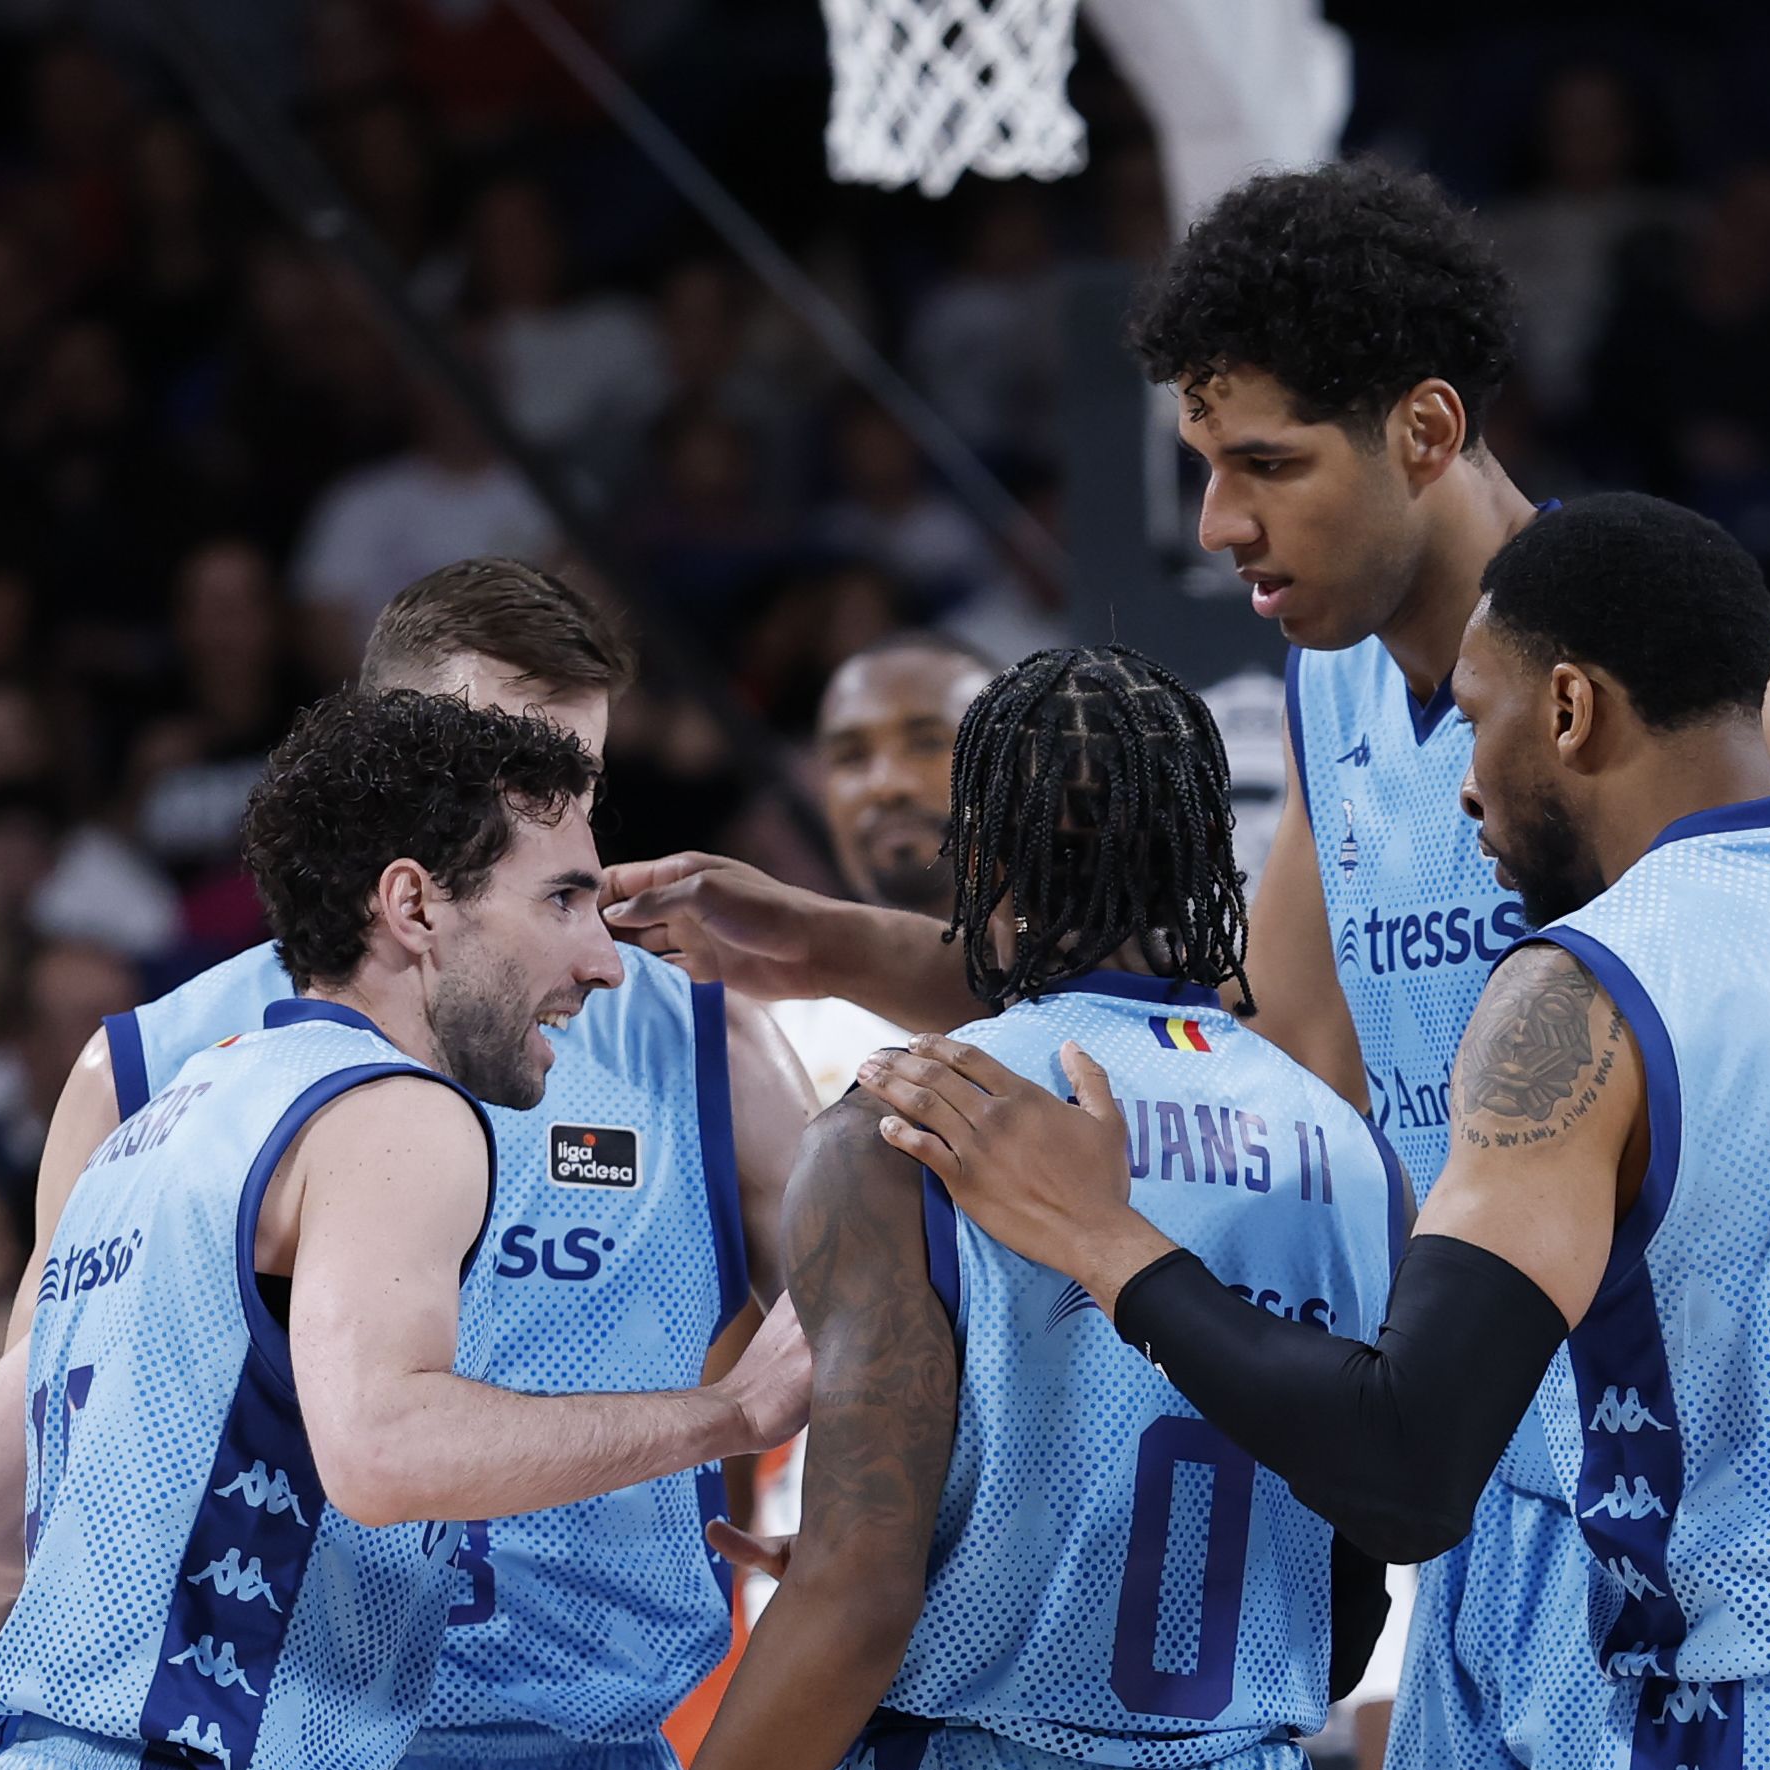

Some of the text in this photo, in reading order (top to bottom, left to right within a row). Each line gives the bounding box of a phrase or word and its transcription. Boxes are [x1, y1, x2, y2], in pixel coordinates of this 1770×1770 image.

[557, 1141, 593, 1162] liga
[1067, 1095, 1271, 1194] VANS
[557, 1161, 633, 1181] endesa
